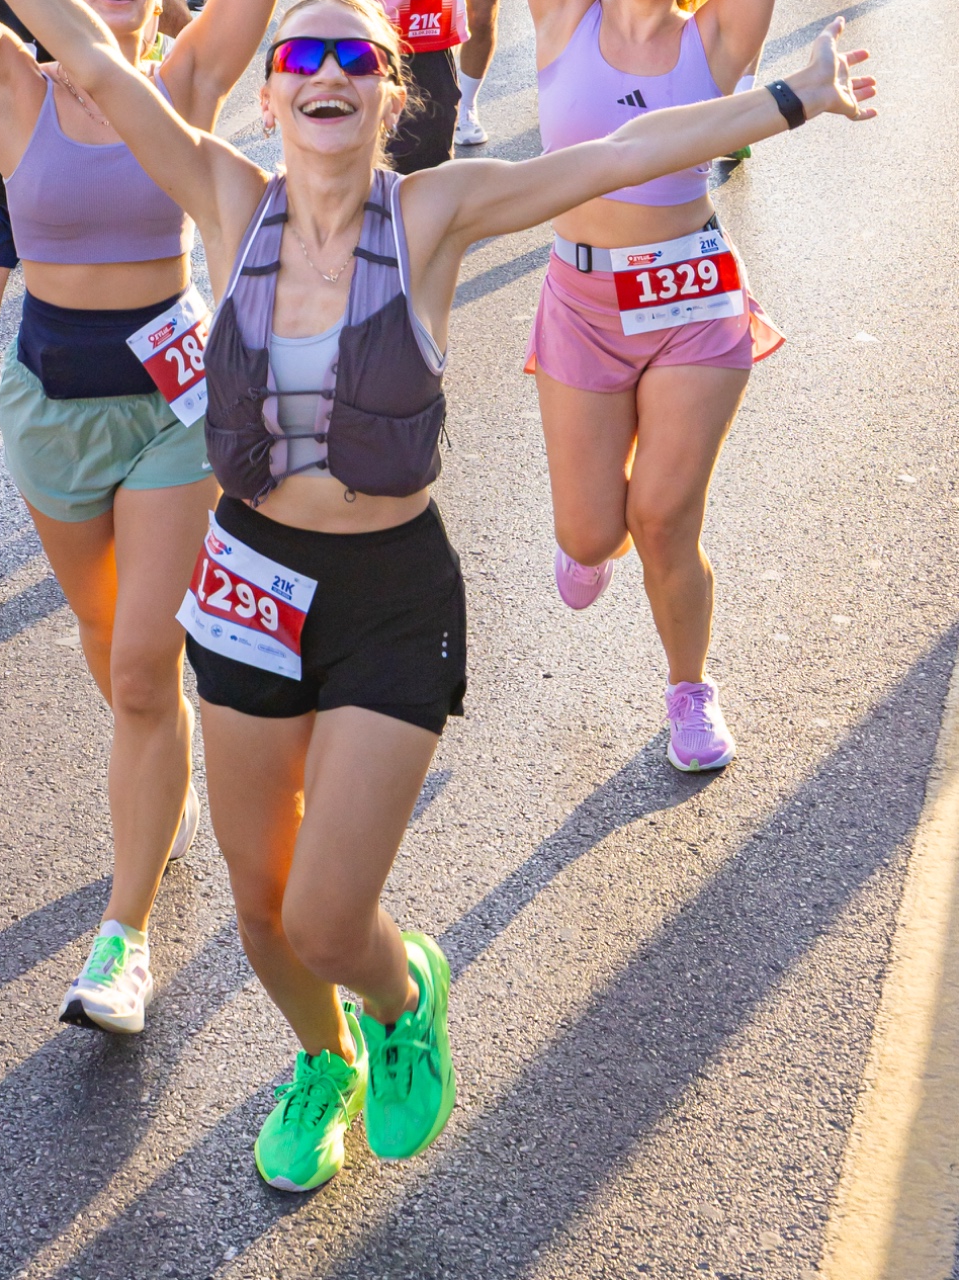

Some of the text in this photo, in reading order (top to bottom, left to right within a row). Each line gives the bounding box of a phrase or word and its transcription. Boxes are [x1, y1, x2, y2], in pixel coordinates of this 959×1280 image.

[409, 12, 443, 30] 21K
[699, 238, 718, 250] 21K
[635, 258, 719, 303] 1329
[197, 558, 279, 632] 1299
[272, 575, 296, 595] 21K
